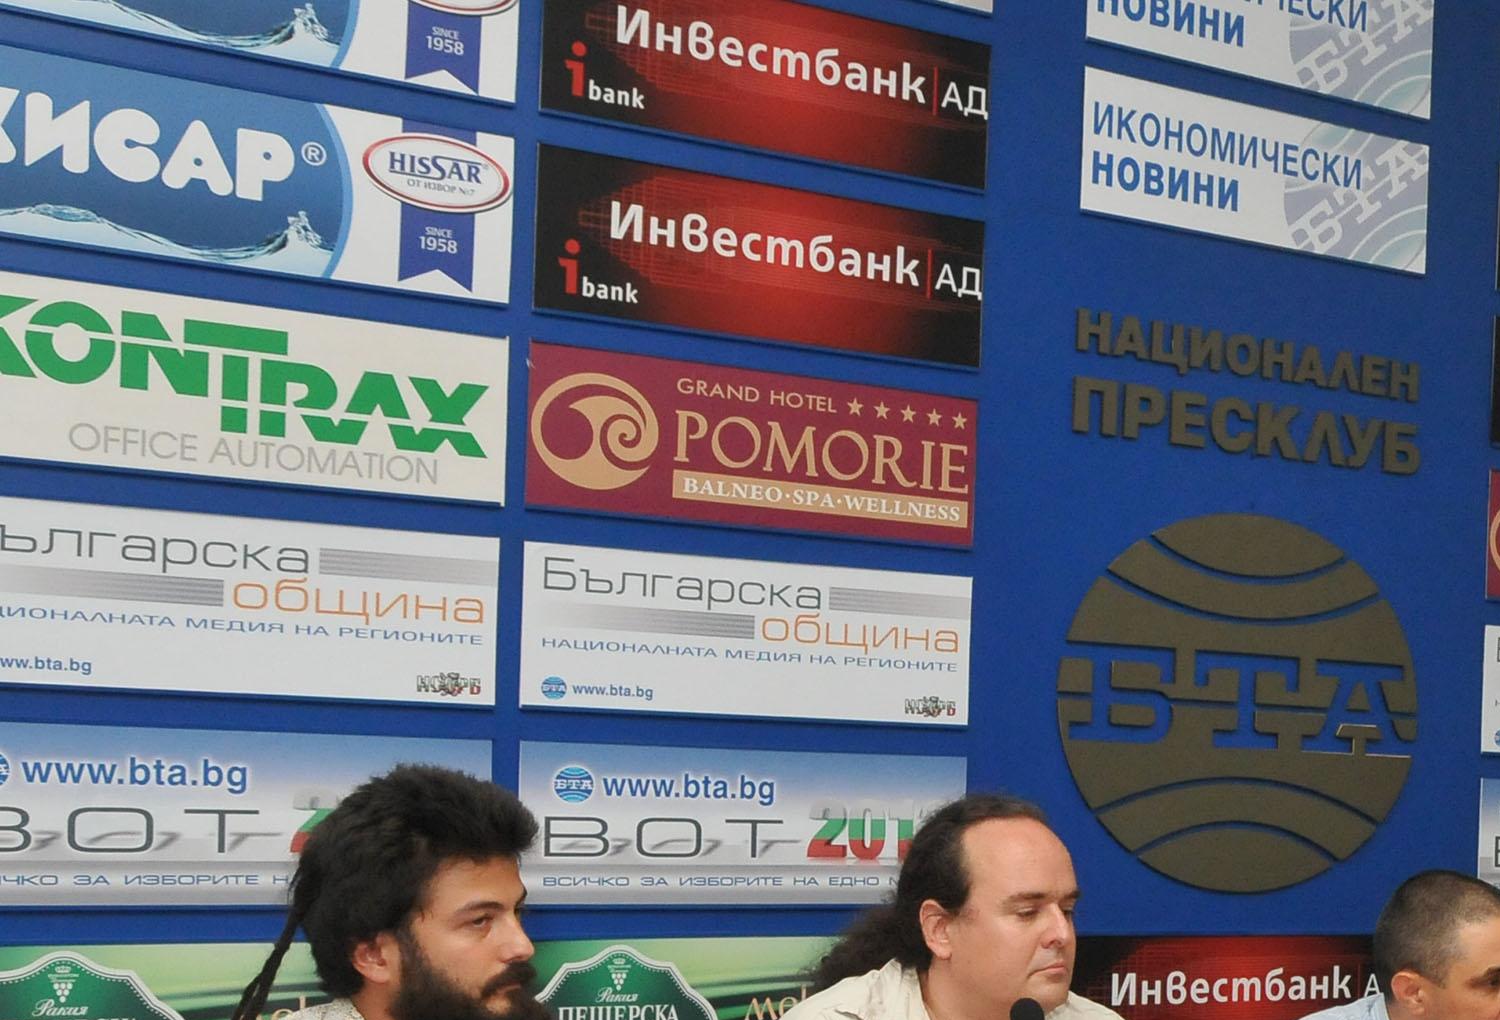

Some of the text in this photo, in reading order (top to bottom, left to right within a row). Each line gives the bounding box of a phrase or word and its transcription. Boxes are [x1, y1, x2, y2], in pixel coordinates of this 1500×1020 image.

[426, 36, 464, 55] 1958
[616, 5, 988, 120] Инвестбанк АД
[588, 79, 645, 110] bank
[0, 88, 295, 202] ИСАР
[1093, 100, 1362, 191] ИКОНОМИЧЕСКИ
[389, 151, 482, 185] HISSAR
[1091, 150, 1240, 212] НОВИНИ
[419, 236, 458, 255] 1958
[609, 200, 982, 300] Инвестбанк АД
[582, 281, 638, 304] bank
[1076, 307, 1420, 403] НАЦИОНАЛЕН
[676, 377, 837, 413] GRAND HOTEL
[1072, 375, 1422, 477] ПРЕСКЛУБ
[68, 422, 438, 485] OFFICE AUTOMATION
[673, 410, 969, 495] POMORIE
[232, 577, 485, 625] община
[543, 556, 821, 611] Българска
[185, 617, 484, 646] МЕДИЯ НА РЕГИОНИТЕ
[761, 611, 959, 655] община
[541, 637, 958, 673] НАЦИОНАЛНАТА МЕДИЯ НА РЕГИОНИТЕ
[572, 682, 654, 702] www.bta.bg
[22, 757, 248, 793] www.bta.bg
[602, 773, 776, 805] www.bta.bg
[73, 875, 259, 886] ЗА ИЗБОРИТЕ
[542, 876, 881, 888] ВСИЧКО ЗА ИЗБОРИТЕ НА ЕДНО
[1111, 965, 1353, 1007] Инвестбанк
